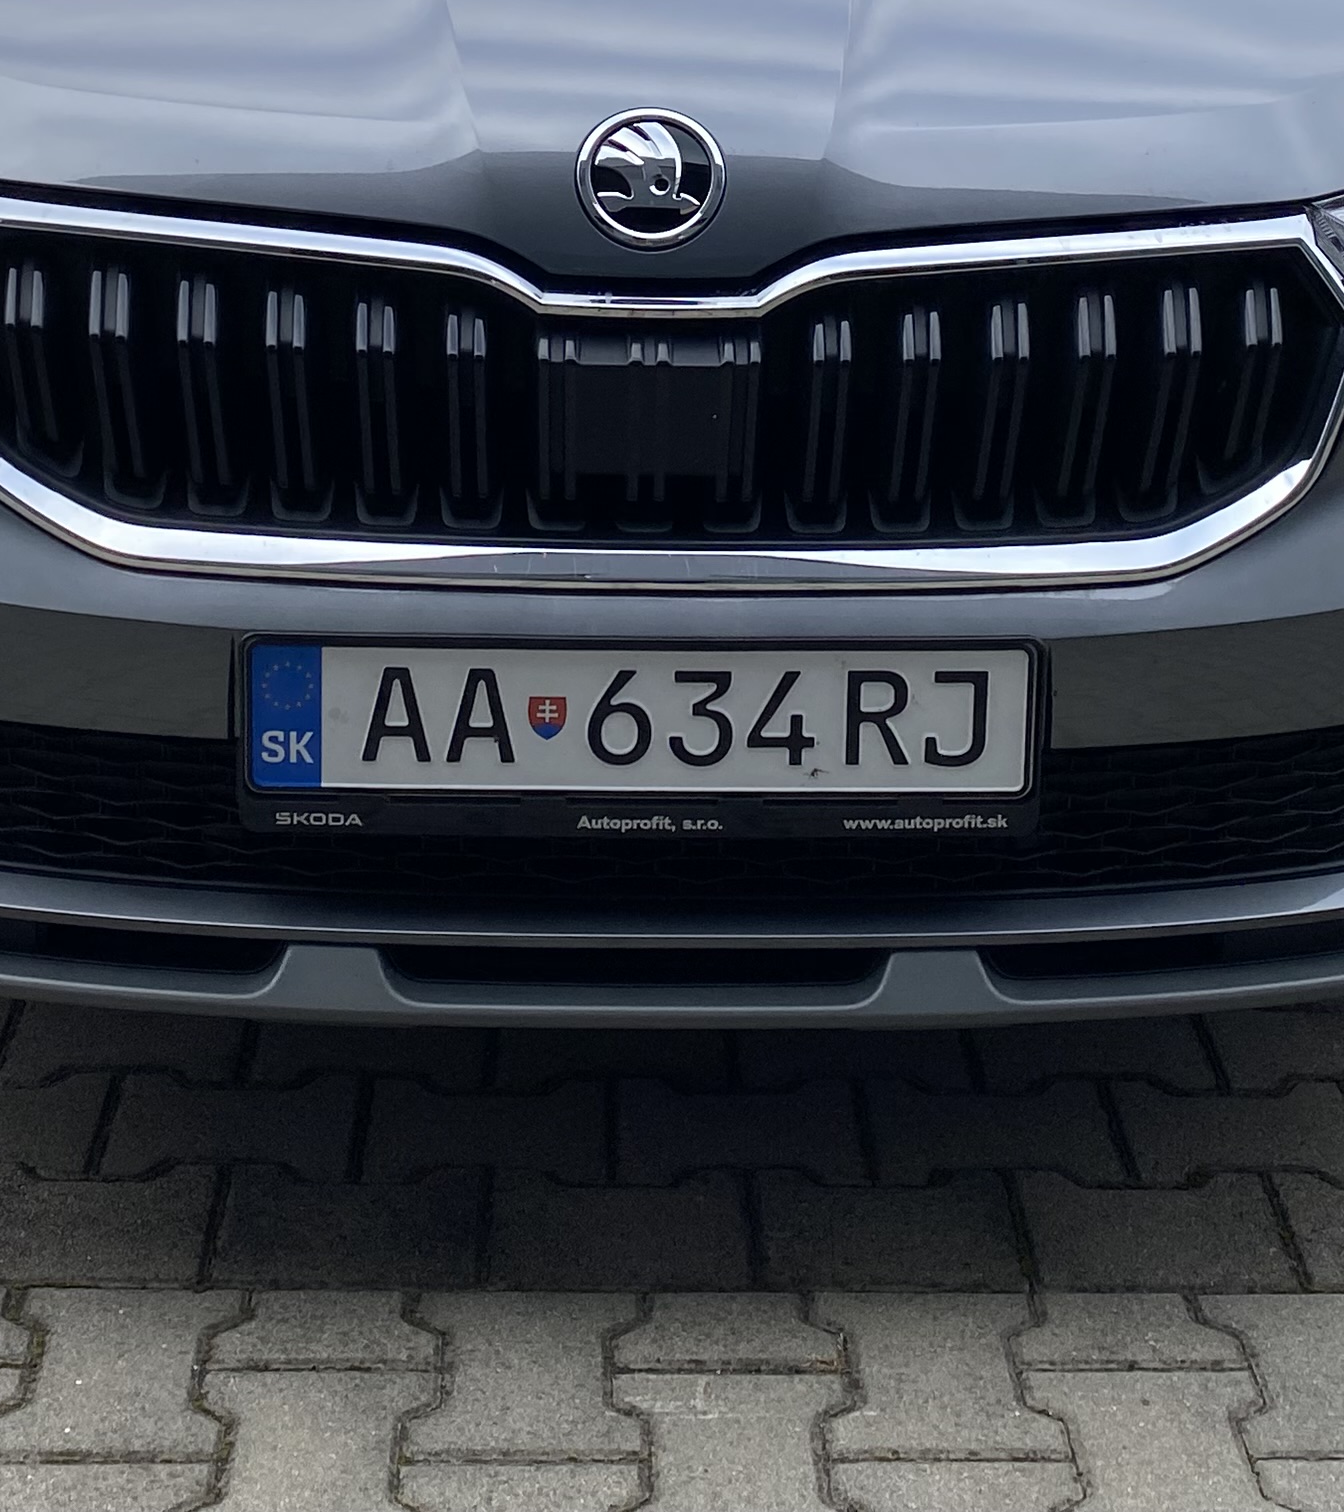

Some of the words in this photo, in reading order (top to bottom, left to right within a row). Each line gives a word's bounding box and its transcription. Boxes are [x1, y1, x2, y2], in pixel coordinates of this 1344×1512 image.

[260, 730, 315, 764] SK
[576, 814, 676, 833] Autoprofit,
[682, 819, 724, 830] s.r.o.
[843, 814, 1008, 832] www.autoprofit.sk
